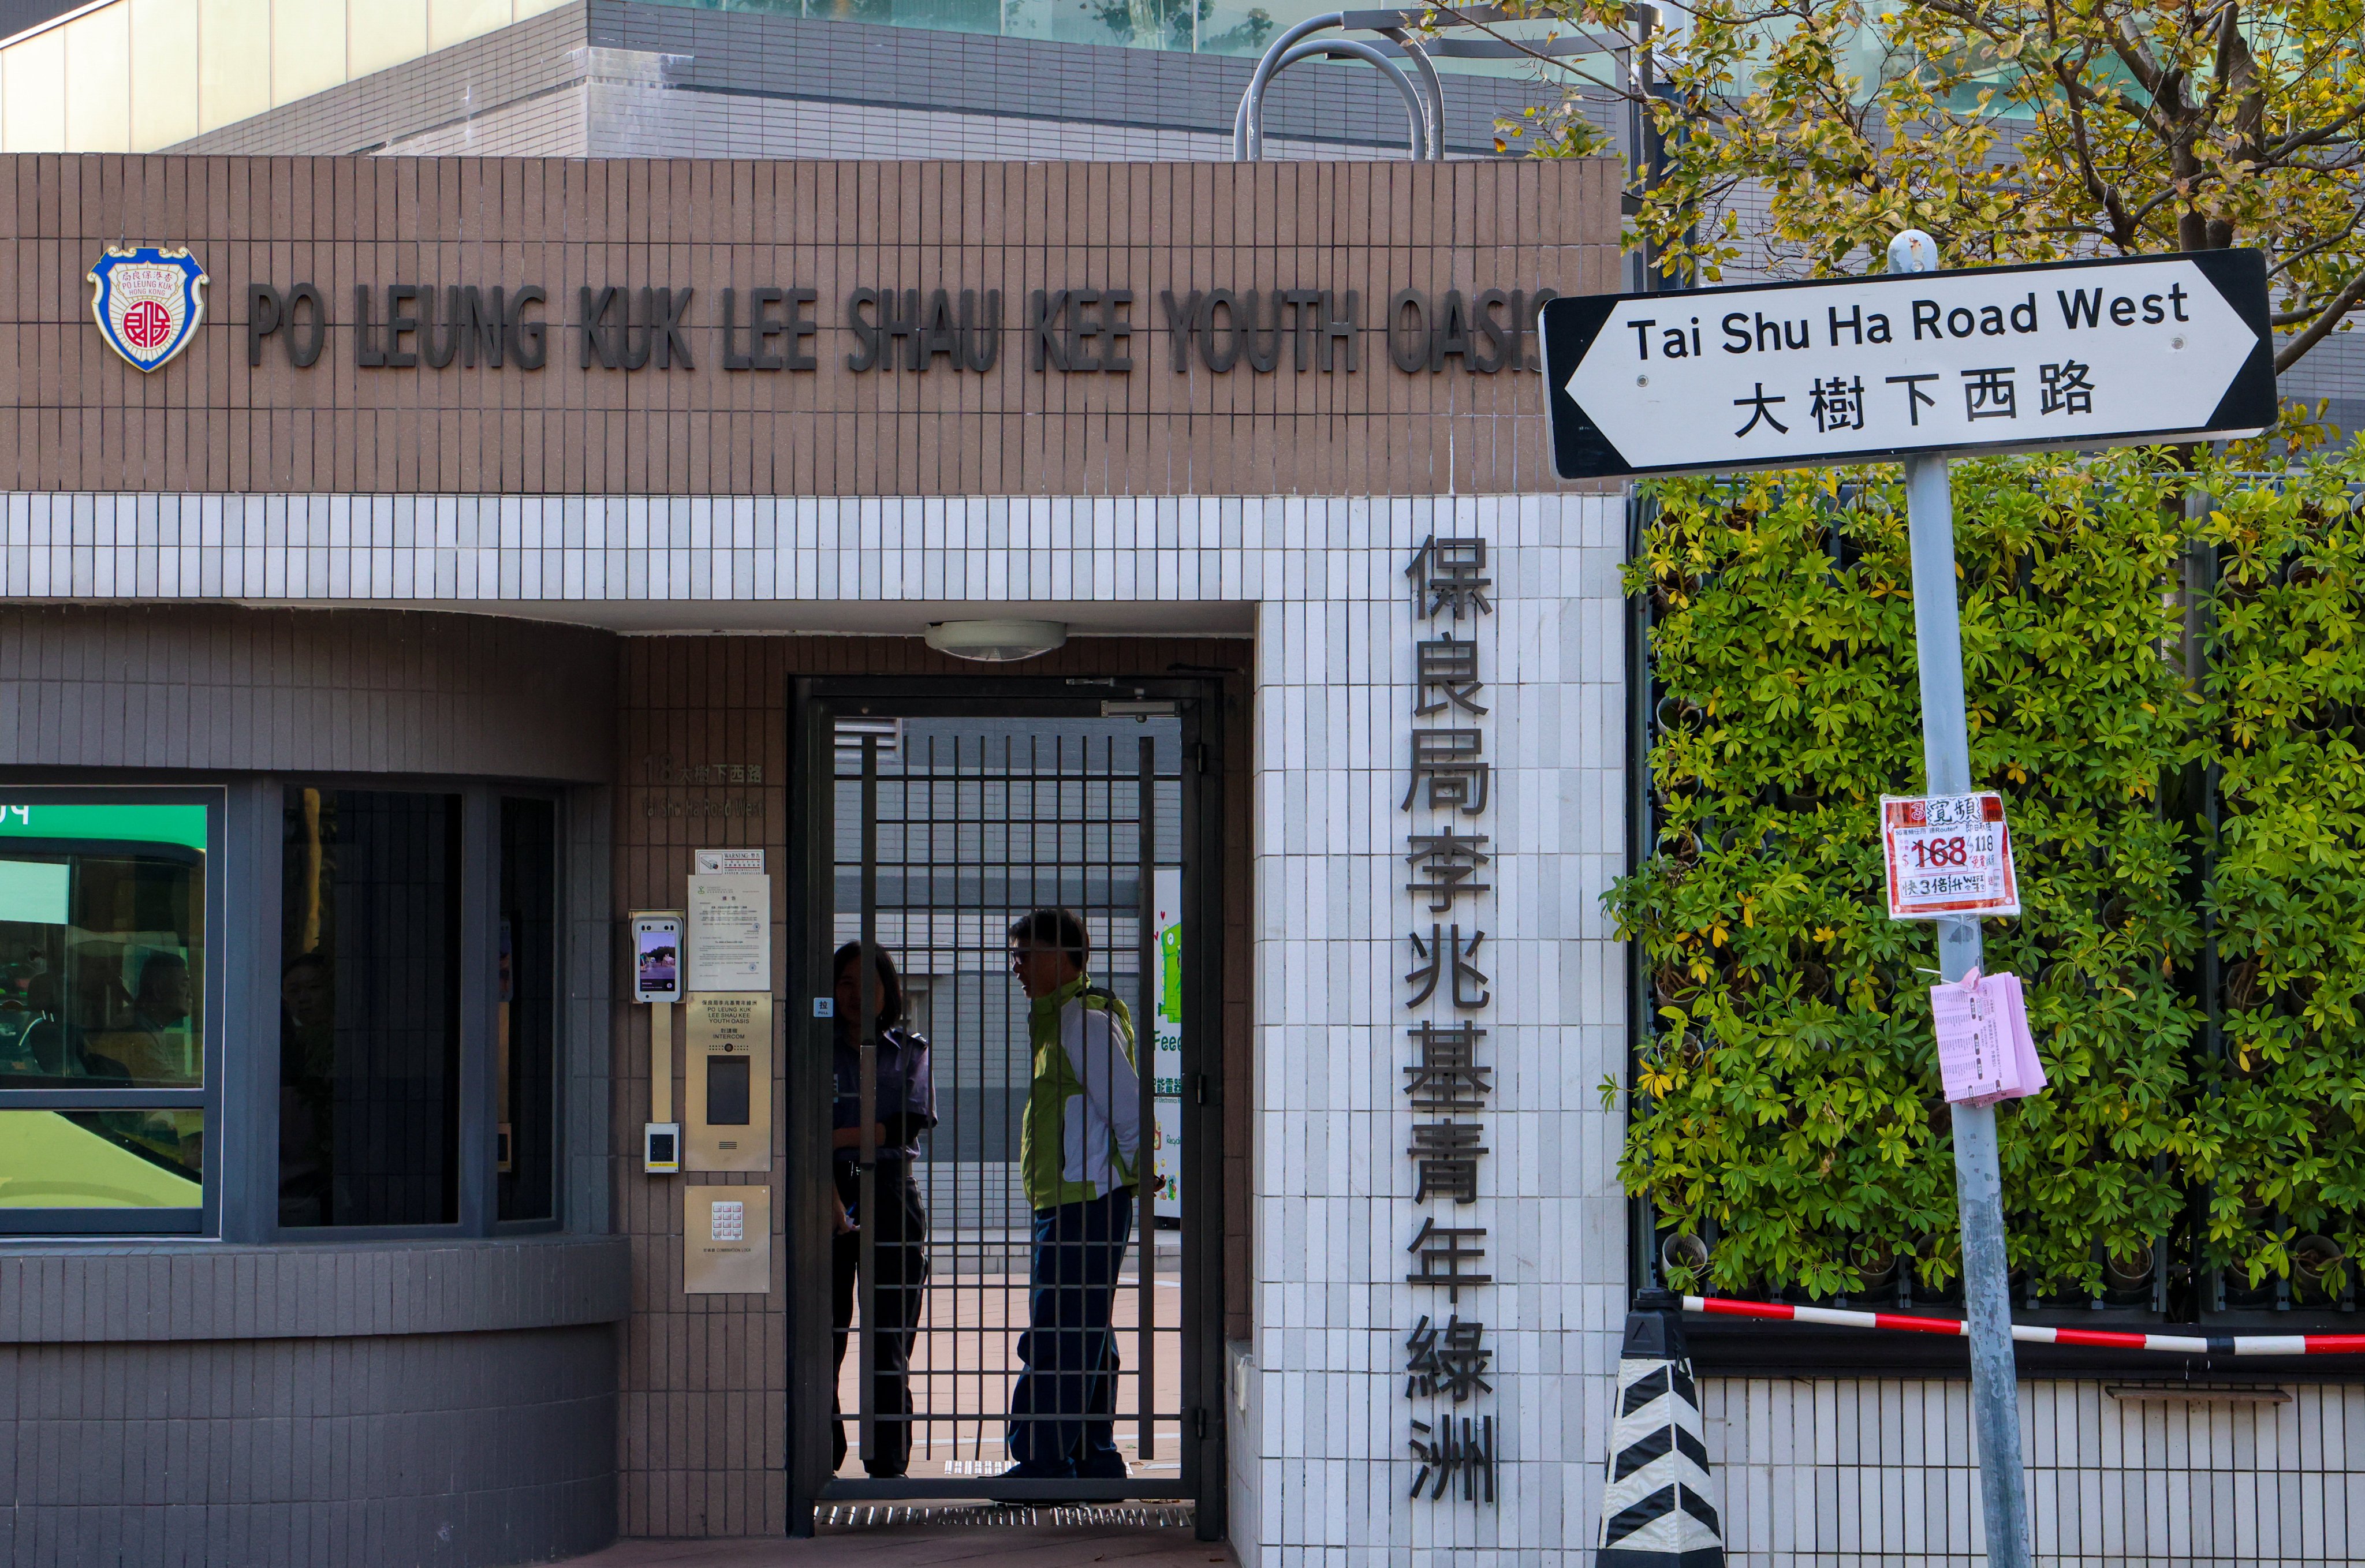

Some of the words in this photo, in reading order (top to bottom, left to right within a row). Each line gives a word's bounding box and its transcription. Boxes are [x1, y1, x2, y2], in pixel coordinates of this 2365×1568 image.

[122, 281, 132, 290] PO
[133, 280, 156, 288] LEUNG
[158, 281, 173, 291] KUK
[248, 282, 326, 368] PO
[356, 283, 546, 371] LEUNG
[579, 286, 695, 371] KUK
[723, 287, 817, 371] LEE
[848, 286, 1000, 373] SHAU
[1033, 288, 1134, 373] KEE
[1160, 287, 1358, 374] YOUTH
[1627, 316, 1702, 360] Tai
[1722, 312, 1810, 354] Shu
[1827, 305, 1893, 348] Ha
[1911, 292, 2039, 342] Road
[2056, 281, 2189, 331] West
[1733, 359, 2097, 439] 大樹下西路
[643, 753, 675, 785] 18
[678, 763, 763, 784] 大樹下西路
[642, 798, 658, 817] Tai
[661, 797, 682, 817] Shu
[685, 798, 701, 817] Ha
[704, 798, 733, 817] Road
[735, 798, 764, 817] West
[1930, 797, 1980, 823] 寬頻
[1911, 836, 1967, 868] 168
[1975, 835, 1993, 852] 118
[1963, 875, 1984, 884] WIFI
[819, 1000, 828, 1009] 拉
[1401, 534, 1493, 1502] 保良局李兆基青年綠洲
